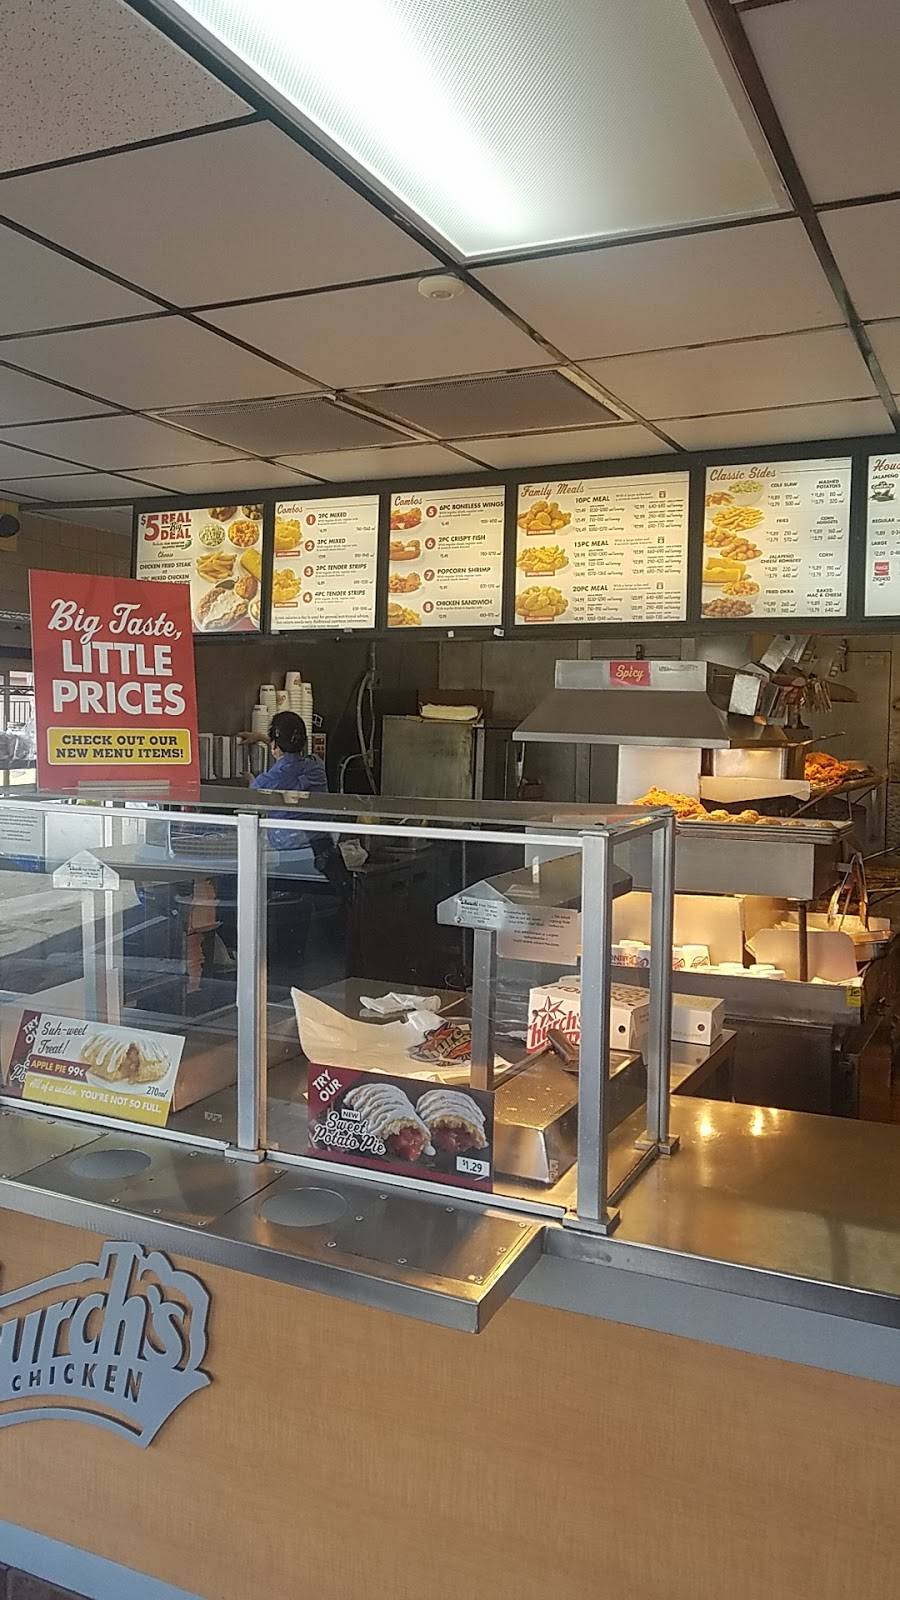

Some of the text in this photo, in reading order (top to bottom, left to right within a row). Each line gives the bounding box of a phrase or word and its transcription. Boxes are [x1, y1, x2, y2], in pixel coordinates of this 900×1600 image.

[710, 466, 776, 482] Classic Sides
[520, 482, 584, 500] Family Meals
[277, 504, 304, 514] Combos
[394, 496, 422, 506] Combos
[452, 502, 480, 510] BONELESS
[161, 512, 192, 525] REAL
[140, 514, 161, 542] $5
[160, 527, 192, 541] DEAL
[48, 598, 182, 644] Big Taste,
[62, 639, 173, 676] LITTLE
[615, 664, 644, 682] Spicy
[52, 679, 186, 716] PRICES
[62, 735, 177, 745] CHECK OUT OUR
[56, 748, 184, 758] NEW MENU ITEMS!
[38, 1040, 69, 1054] Treat!
[31, 1060, 84, 1076] APPLE PIE 99¢
[312, 1070, 331, 1090] TRY
[146, 1085, 158, 1095] 270
[320, 1078, 342, 1101] OUR
[81, 1088, 108, 1103] YOU'RE
[110, 1095, 128, 1106] NOT
[129, 1100, 141, 1108] SO
[327, 1112, 368, 1134] Sweet
[343, 1111, 359, 1119] NEW
[314, 1125, 385, 1155] Potato Pie
[462, 1160, 482, 1173] $1.29
[12, 1362, 143, 1403] CHICKEN
